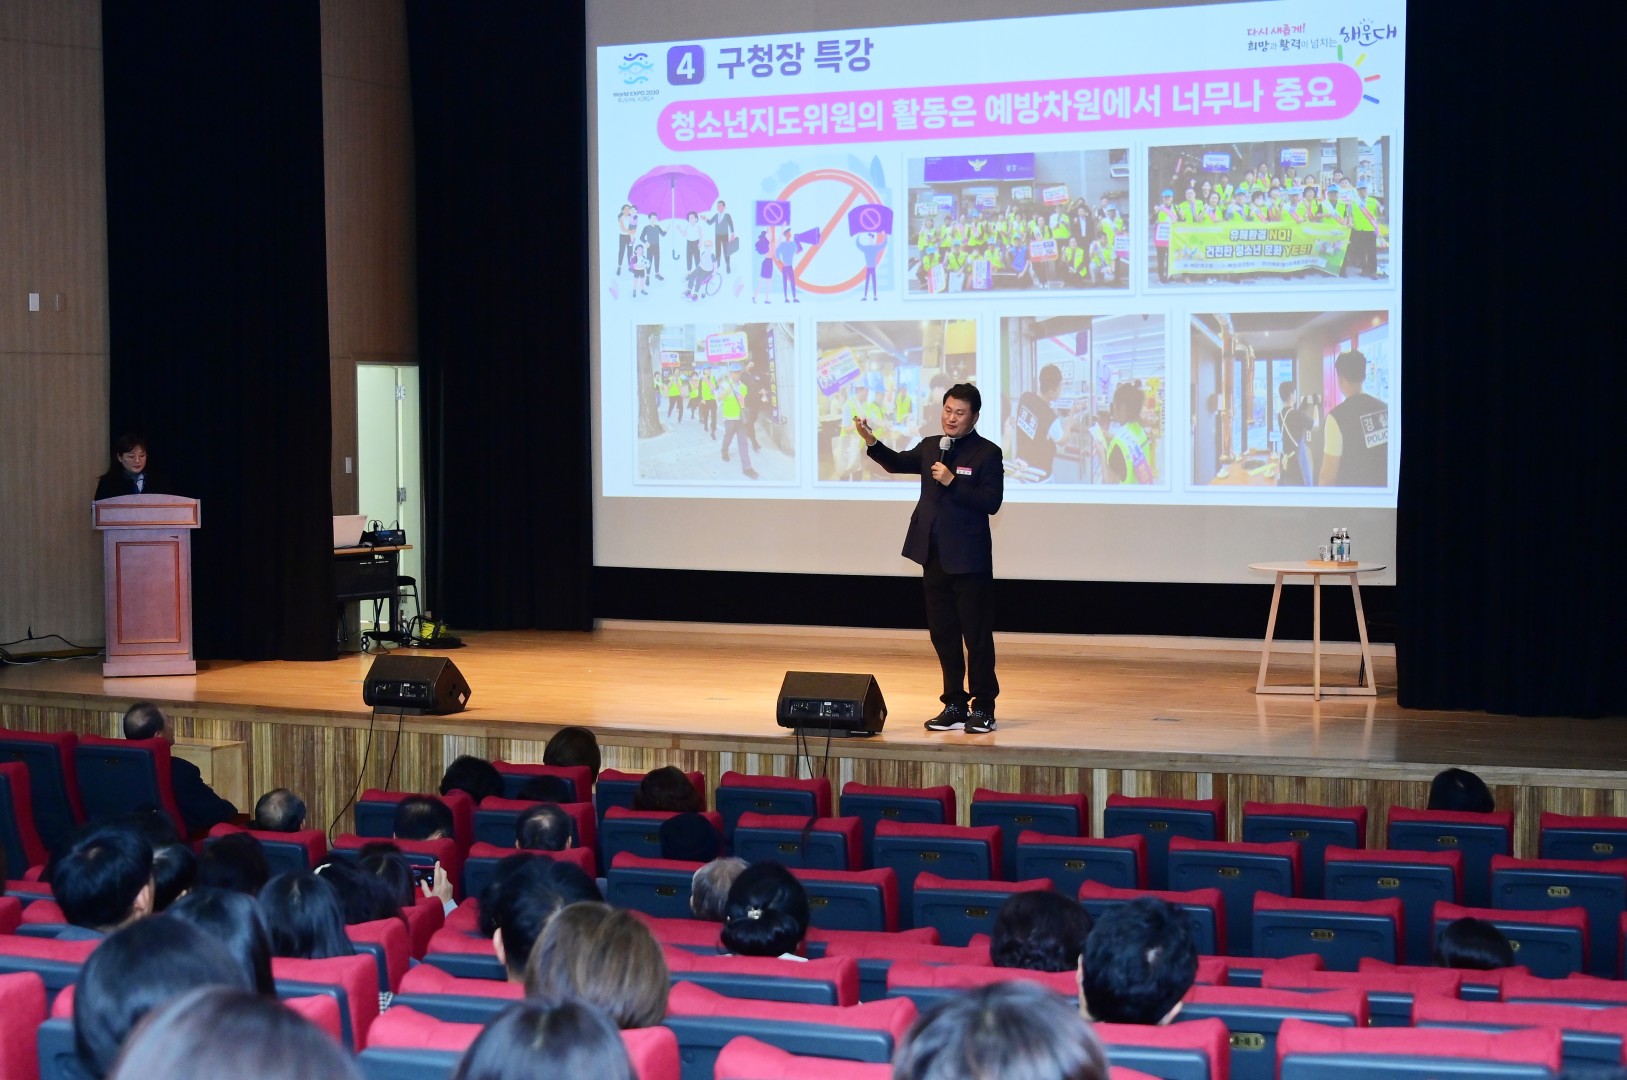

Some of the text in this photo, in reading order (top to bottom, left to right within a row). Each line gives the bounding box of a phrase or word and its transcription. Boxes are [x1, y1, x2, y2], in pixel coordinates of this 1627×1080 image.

[1247, 22, 1306, 36] 다시 새롭게!
[1339, 23, 1398, 47] 해운대
[1247, 40, 1277, 52] 희망과
[1310, 37, 1338, 49] 넘치는
[675, 52, 696, 80] 4
[717, 37, 874, 80] 구청장 특강
[671, 76, 1337, 142] 청소년지도위원의 활동은 예방차원에서 너무나 중요
[1268, 228, 1292, 242] NO!
[1235, 244, 1263, 258] 청소년
[1284, 244, 1312, 258] YES!
